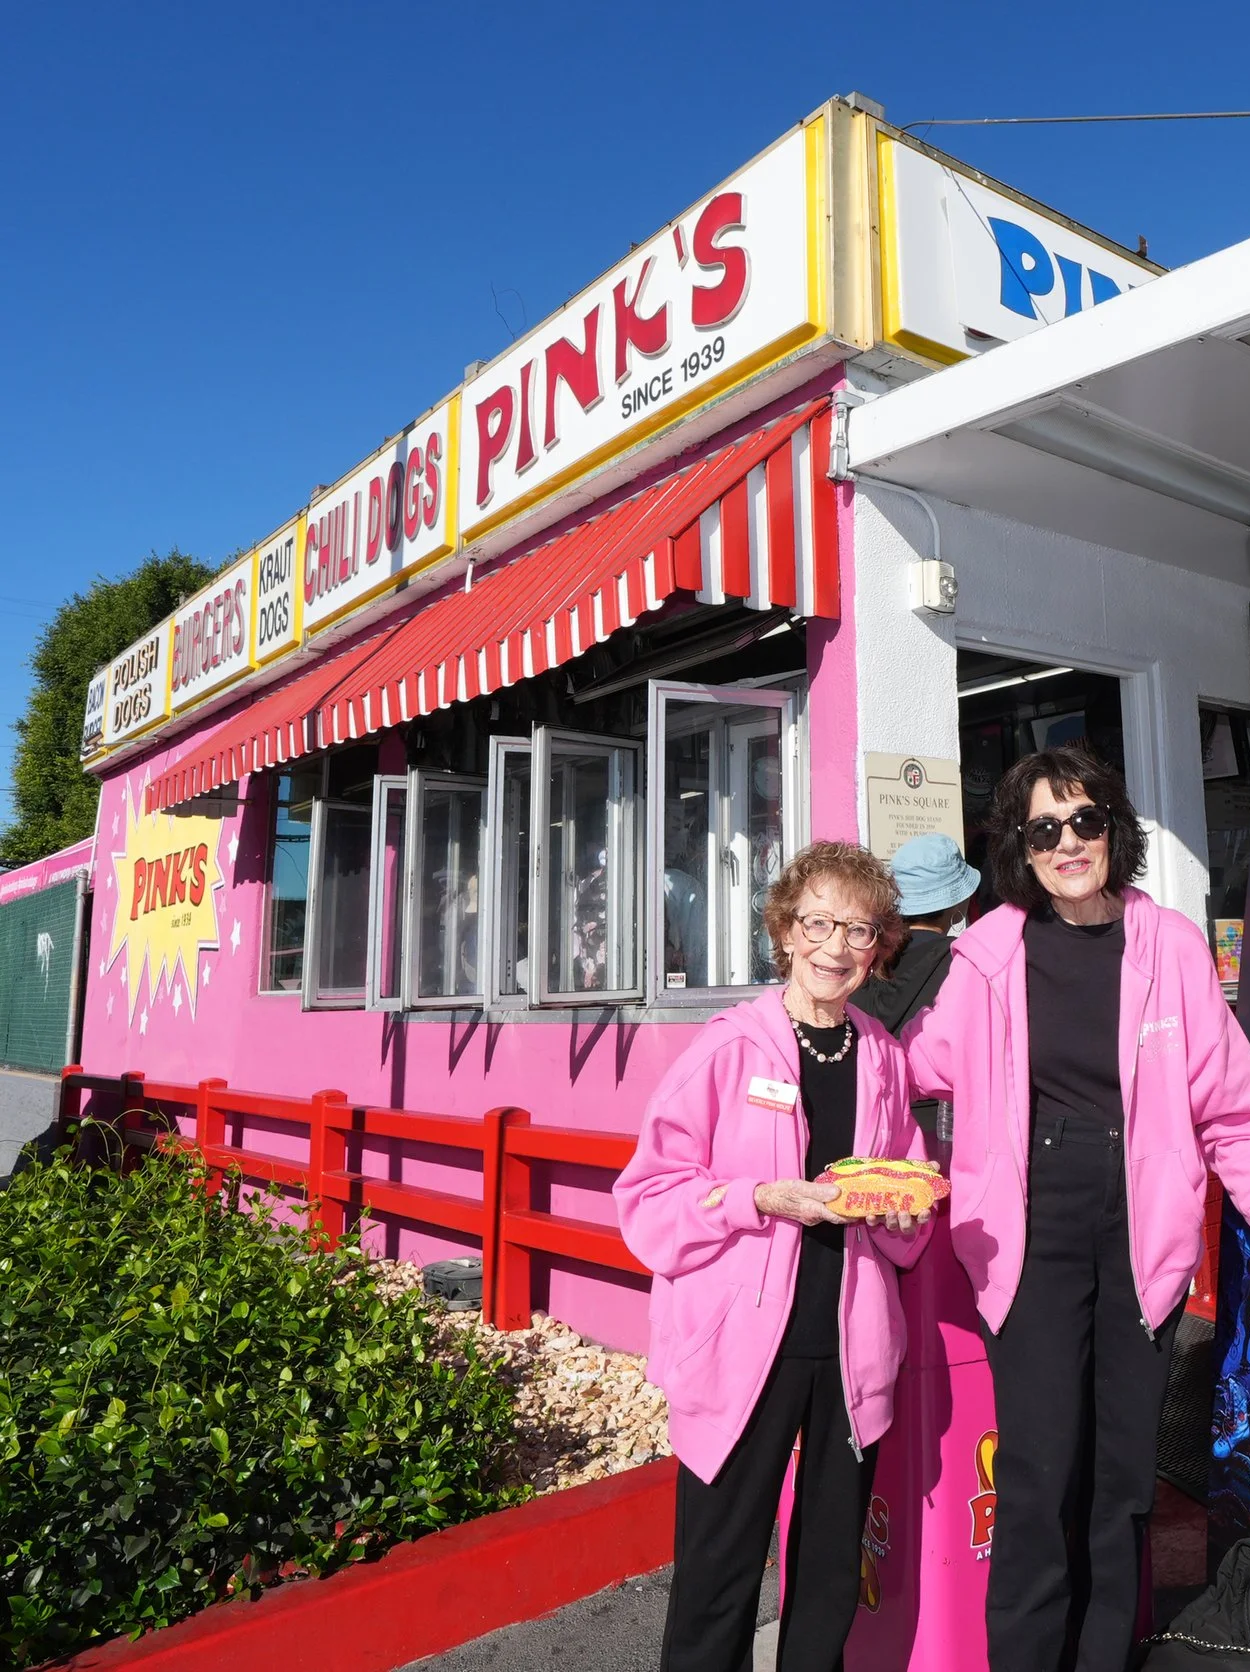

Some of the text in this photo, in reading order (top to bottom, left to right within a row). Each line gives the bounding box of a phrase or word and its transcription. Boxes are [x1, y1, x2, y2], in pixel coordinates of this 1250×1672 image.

[475, 191, 752, 510] PINK'S
[621, 336, 725, 419] SINCE 1939
[304, 432, 442, 606] CHILI DOGS
[258, 536, 294, 598] KRAUT
[171, 578, 247, 692] BURGERS
[259, 591, 290, 646] DOGS
[113, 635, 160, 697] POLISH
[112, 683, 152, 734] DOGS
[879, 793, 950, 810] PINK'S SQUARE
[130, 842, 209, 921] PINK'S
[844, 1190, 917, 1213] PINK'S
